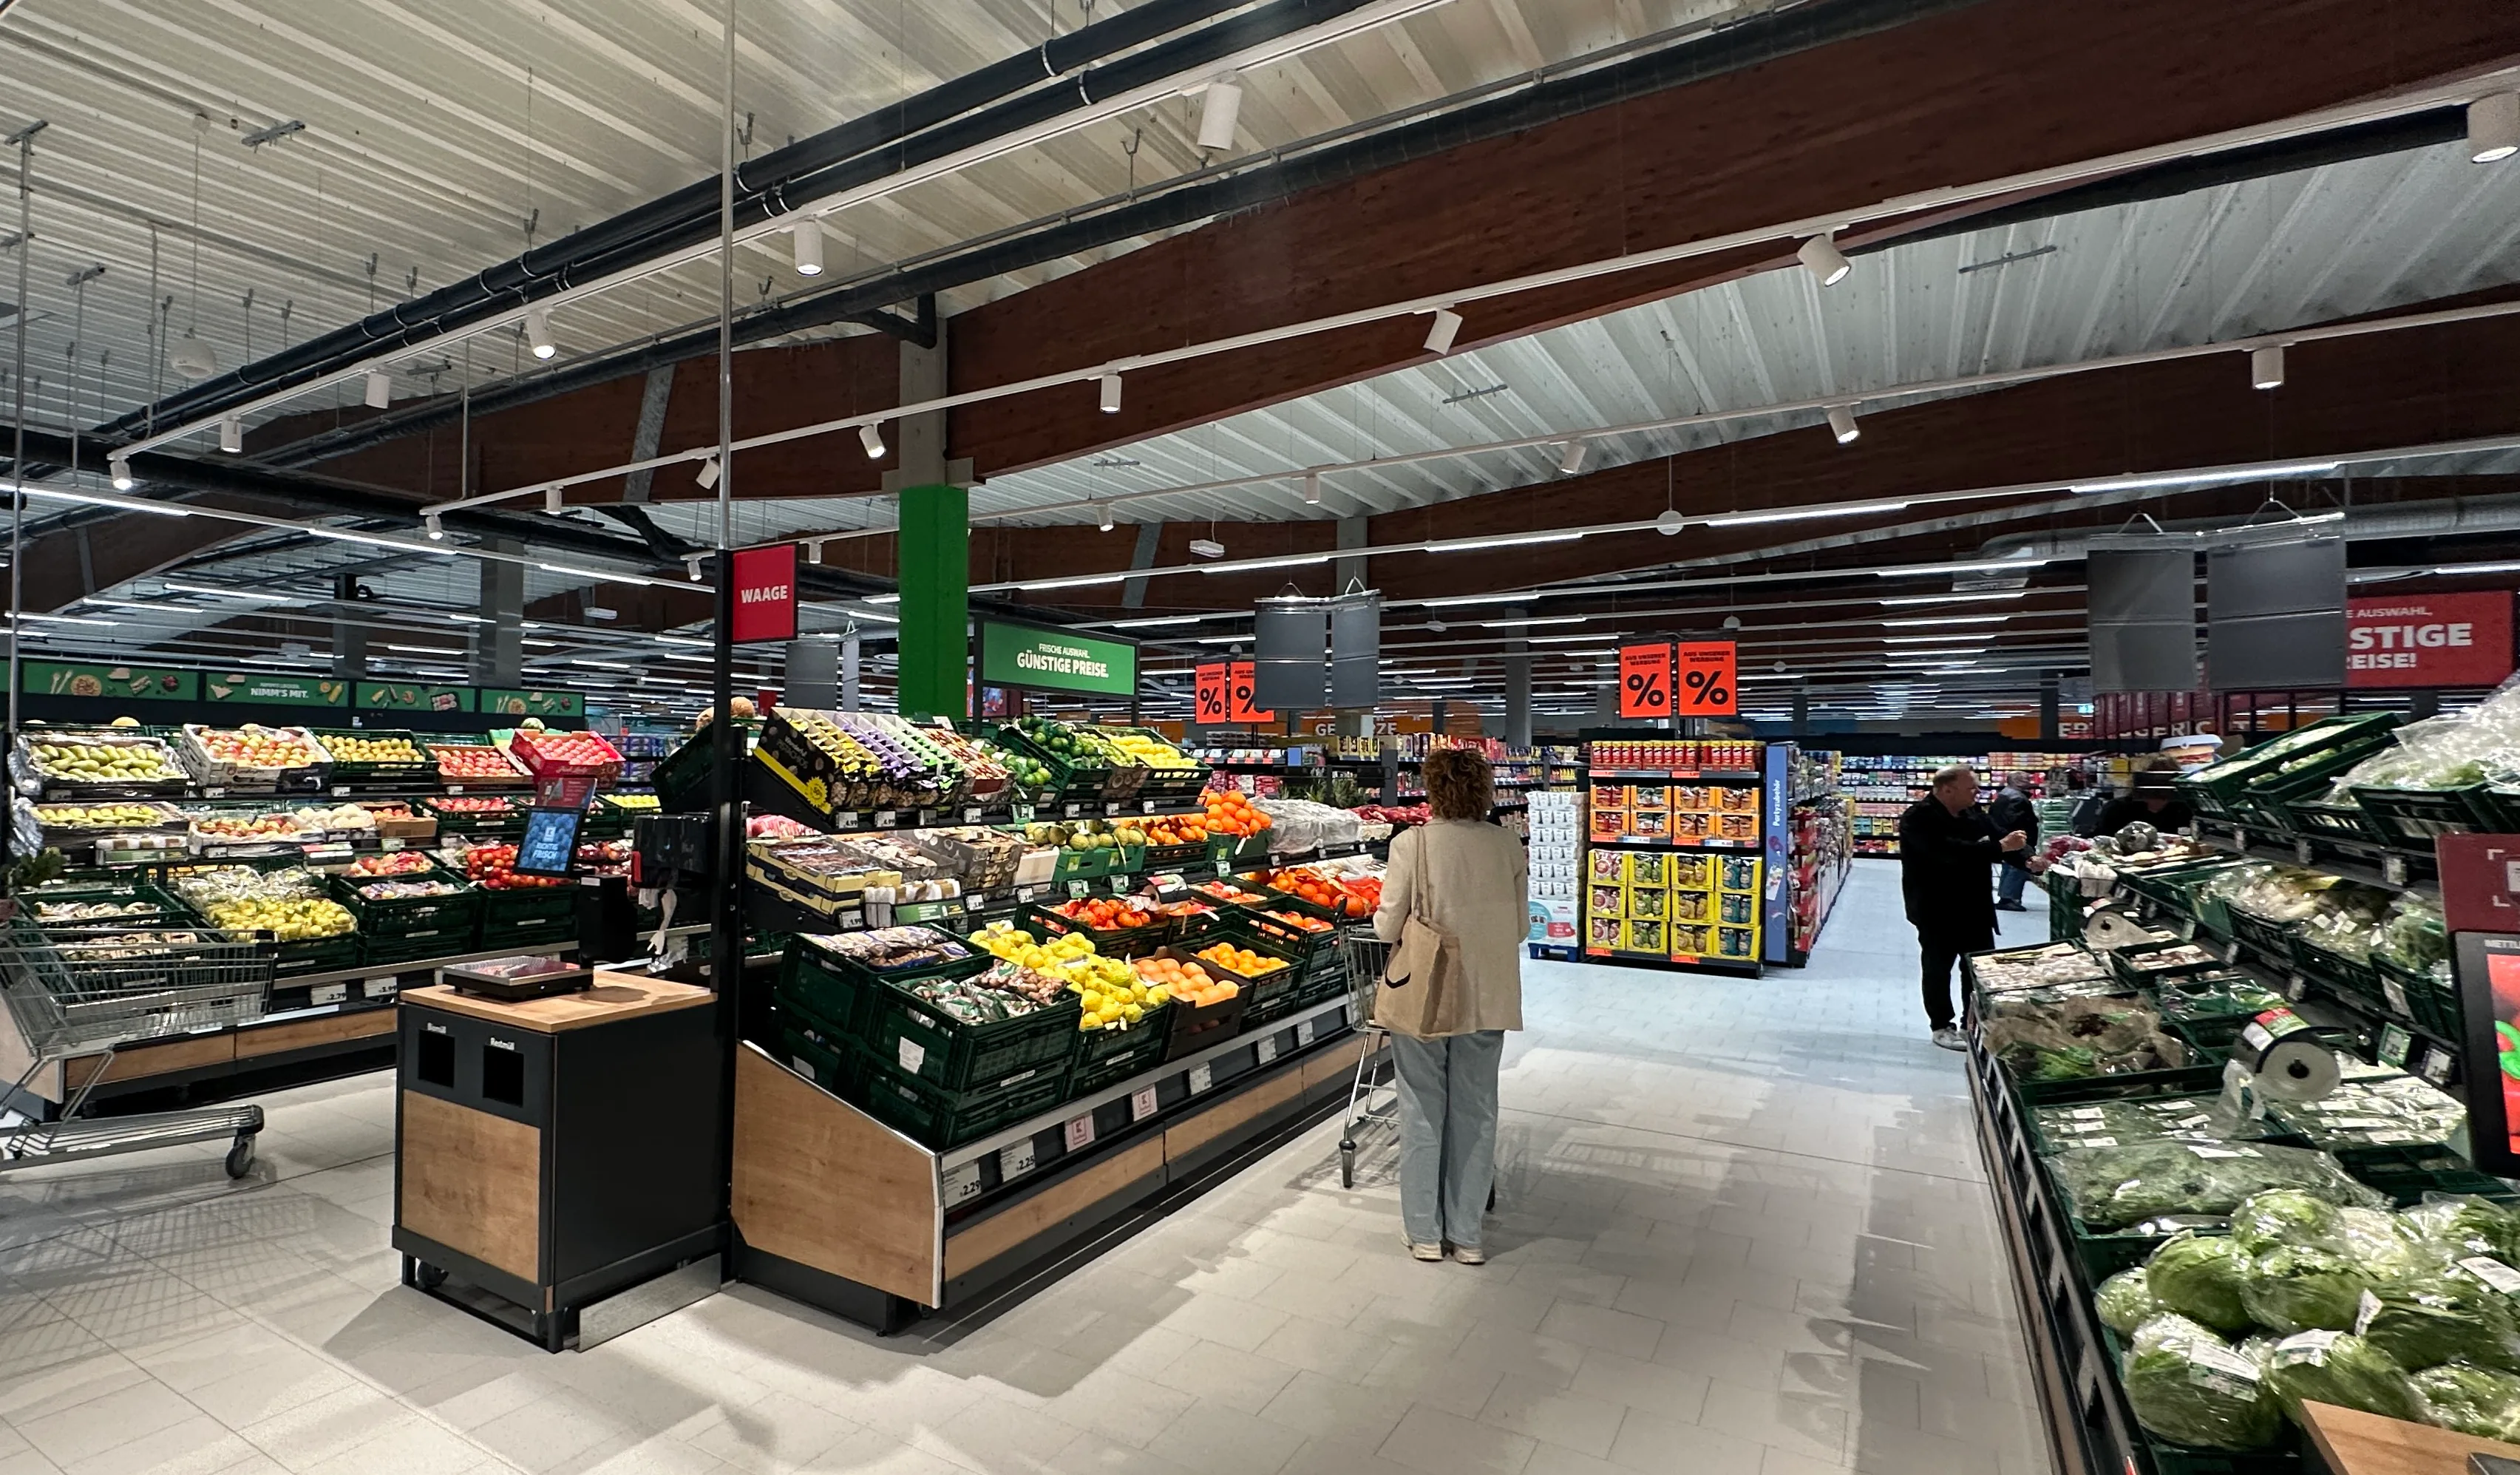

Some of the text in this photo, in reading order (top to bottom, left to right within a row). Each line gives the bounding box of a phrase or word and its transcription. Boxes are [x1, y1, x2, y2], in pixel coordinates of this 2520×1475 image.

[741, 585, 788, 603] WAAGE
[1039, 643, 1062, 655] FRISCHE
[2349, 623, 2473, 650] STIGE
[1016, 649, 1071, 674] GÜNSTIGE
[2346, 653, 2417, 670] EISE!
[1627, 673, 1665, 708] %
[1685, 671, 1728, 705] %
[1200, 687, 1222, 715] %
[532, 850, 557, 859] FRISCH
